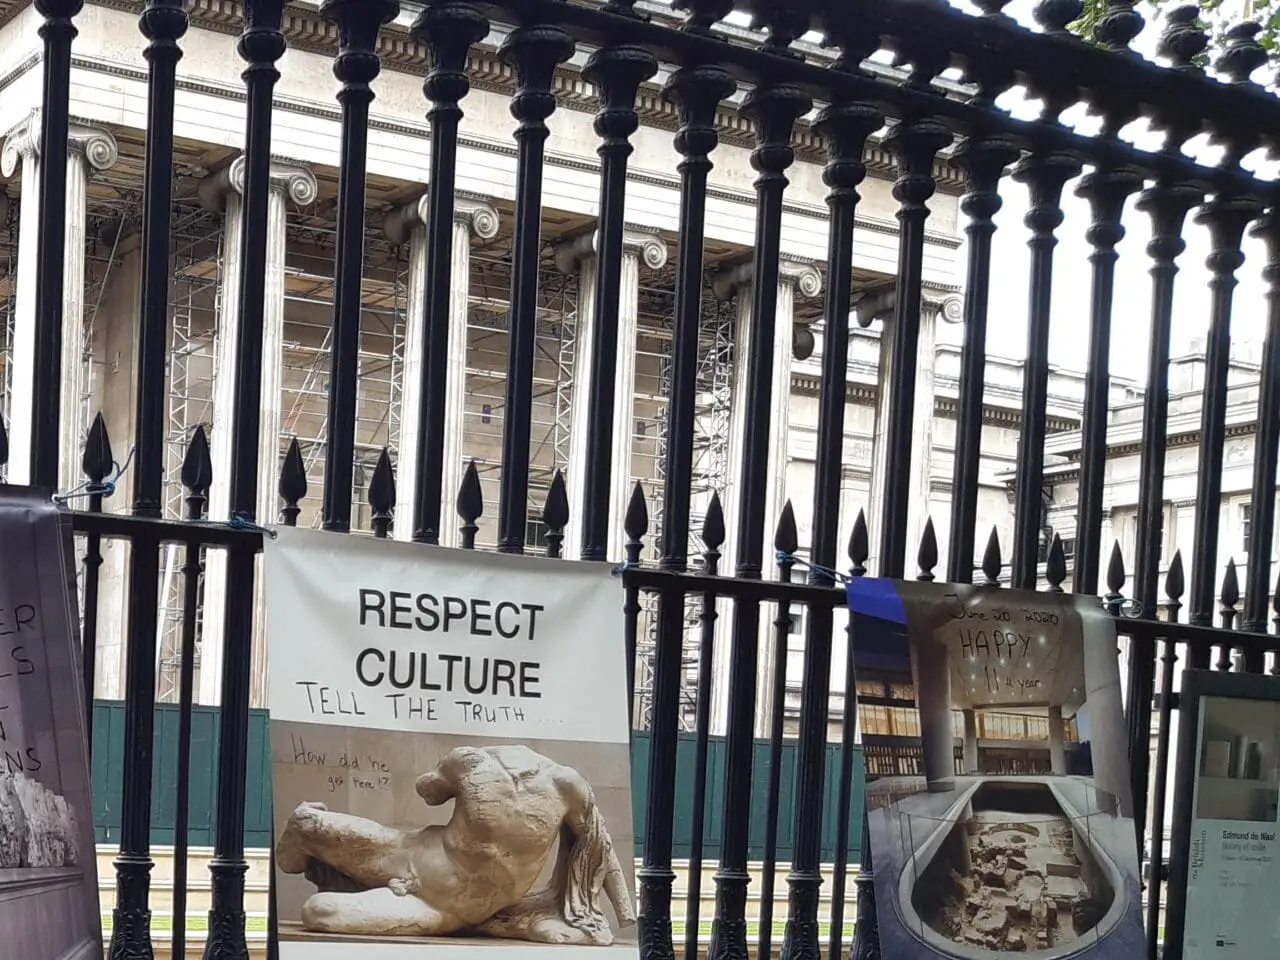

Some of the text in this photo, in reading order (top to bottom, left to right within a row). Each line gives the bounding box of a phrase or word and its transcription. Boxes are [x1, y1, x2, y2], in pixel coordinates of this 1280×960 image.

[358, 588, 544, 641] RESPECT
[943, 593, 989, 621] June
[1023, 608, 1059, 625] 2020
[959, 628, 1031, 659] HAPPY
[355, 647, 542, 699] CULTURE
[296, 681, 365, 715] TELL
[384, 693, 438, 721] THE
[290, 732, 326, 765] How
